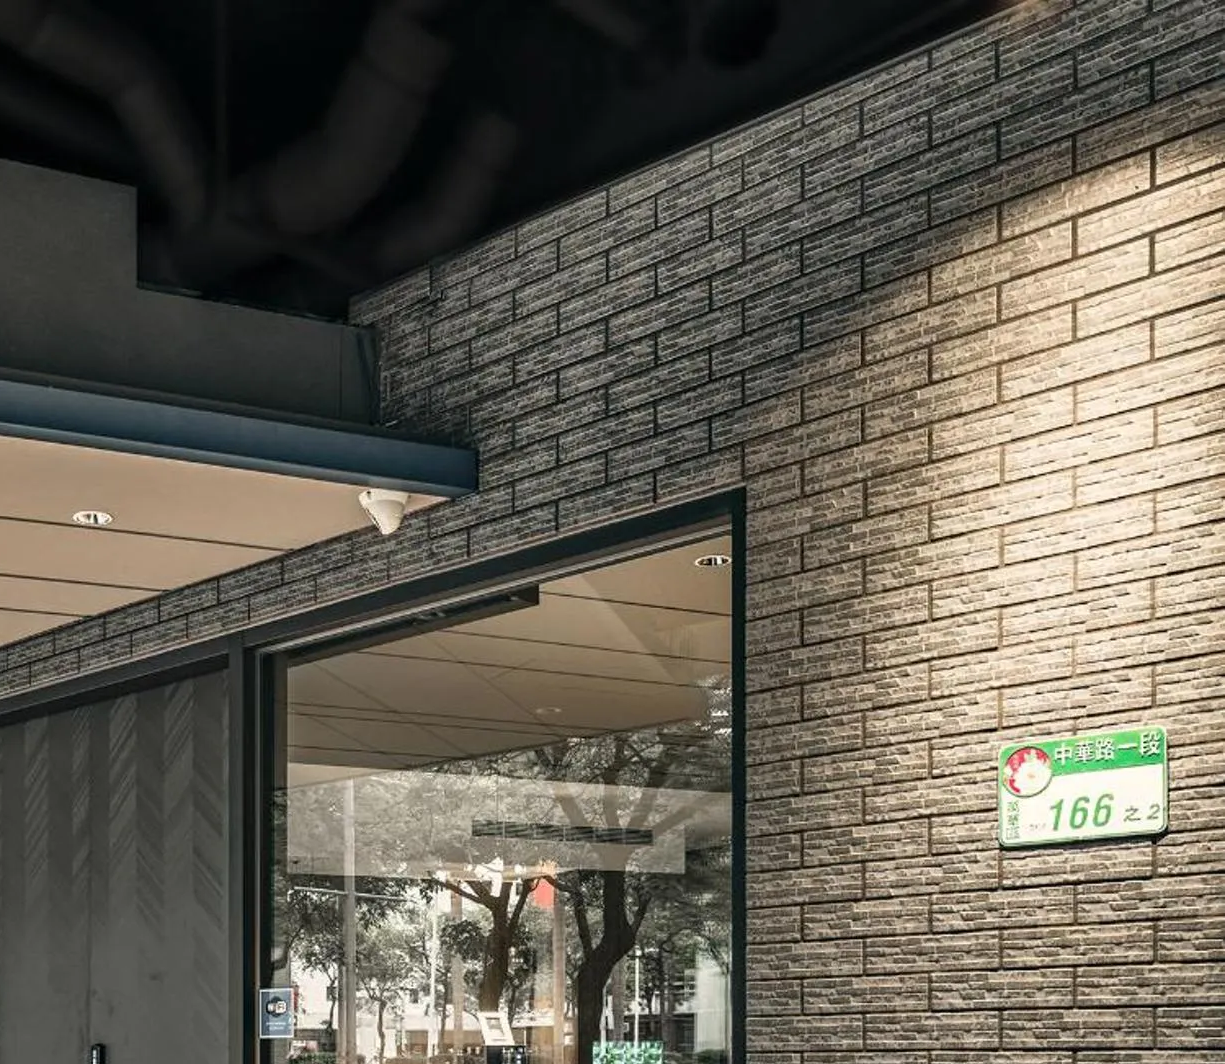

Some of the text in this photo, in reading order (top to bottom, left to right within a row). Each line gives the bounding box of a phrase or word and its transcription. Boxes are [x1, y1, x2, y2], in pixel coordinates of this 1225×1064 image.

[1053, 731, 1162, 766] 中華路一段
[1050, 793, 1115, 832] 166
